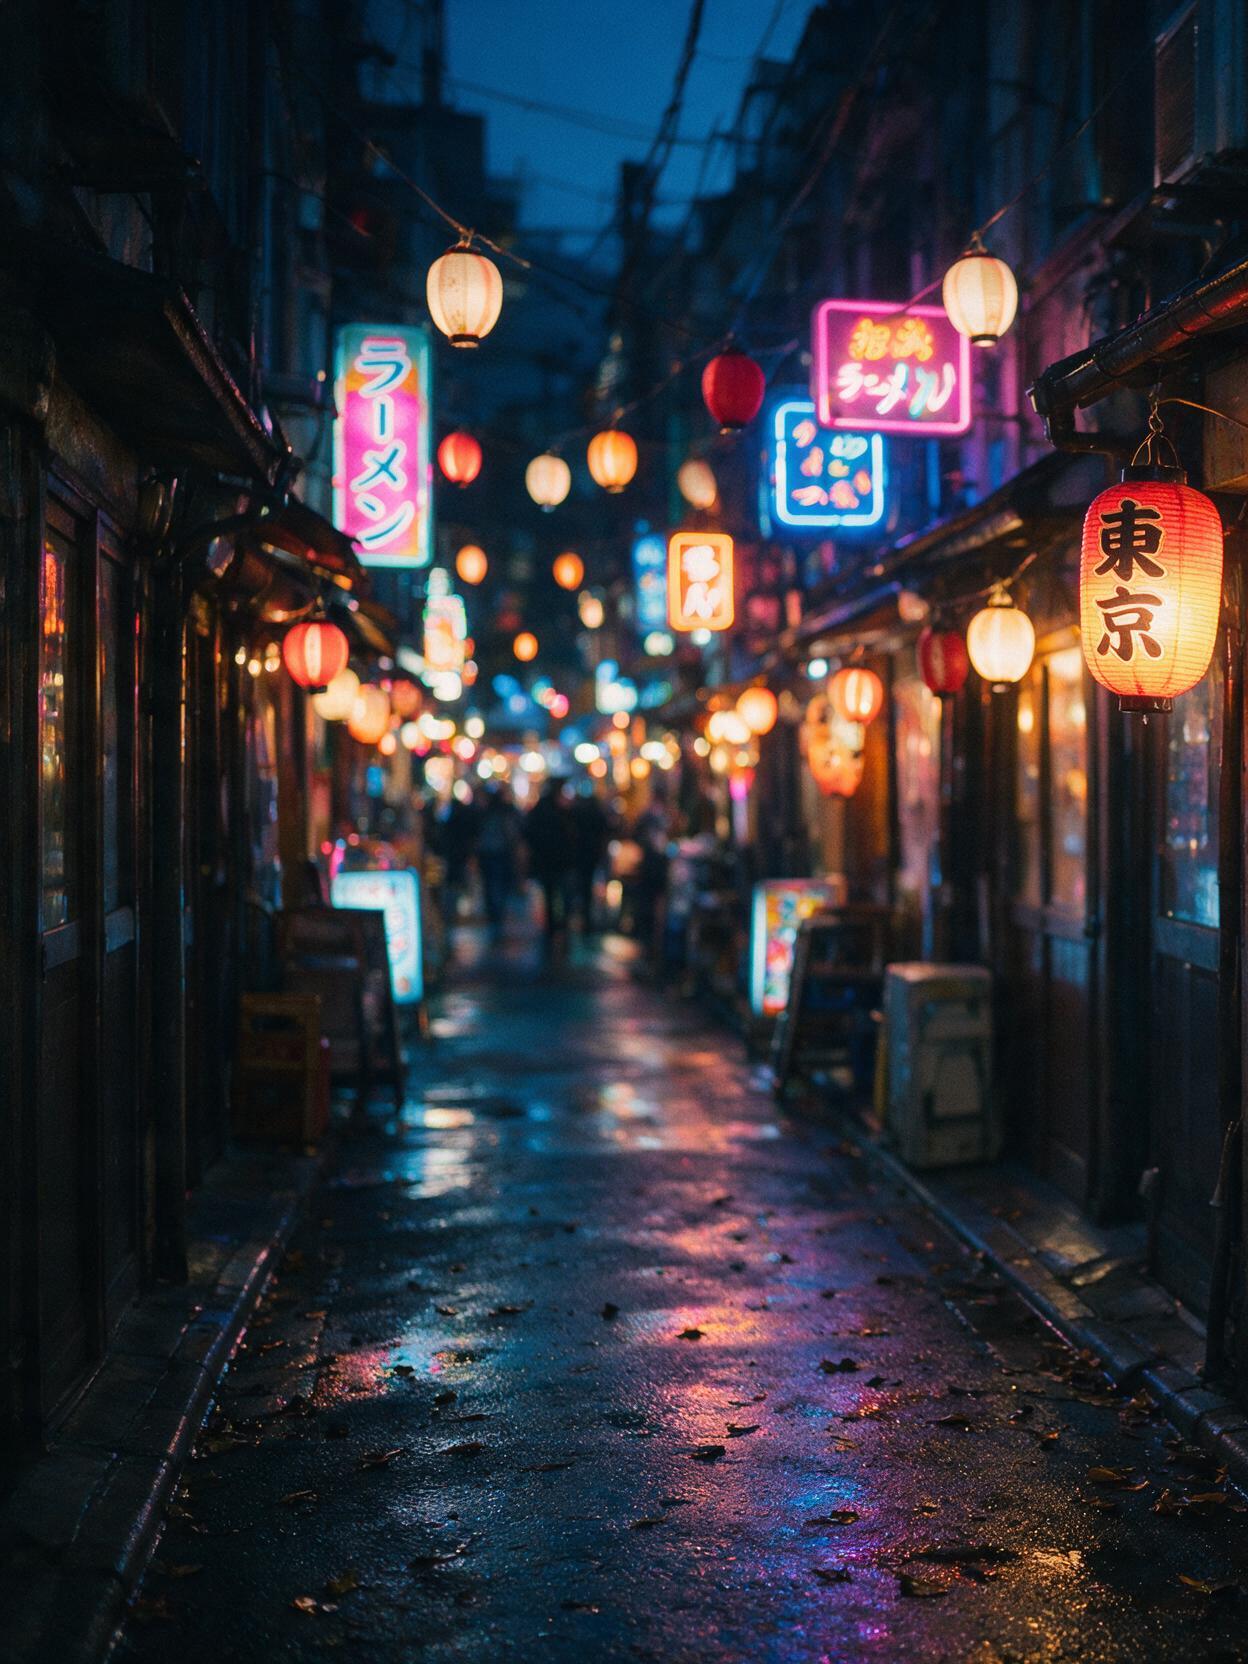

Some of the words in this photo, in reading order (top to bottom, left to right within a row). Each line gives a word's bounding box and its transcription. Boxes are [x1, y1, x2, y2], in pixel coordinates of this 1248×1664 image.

[354, 339, 413, 549] ラーメン
[1095, 499, 1165, 662] 東京
